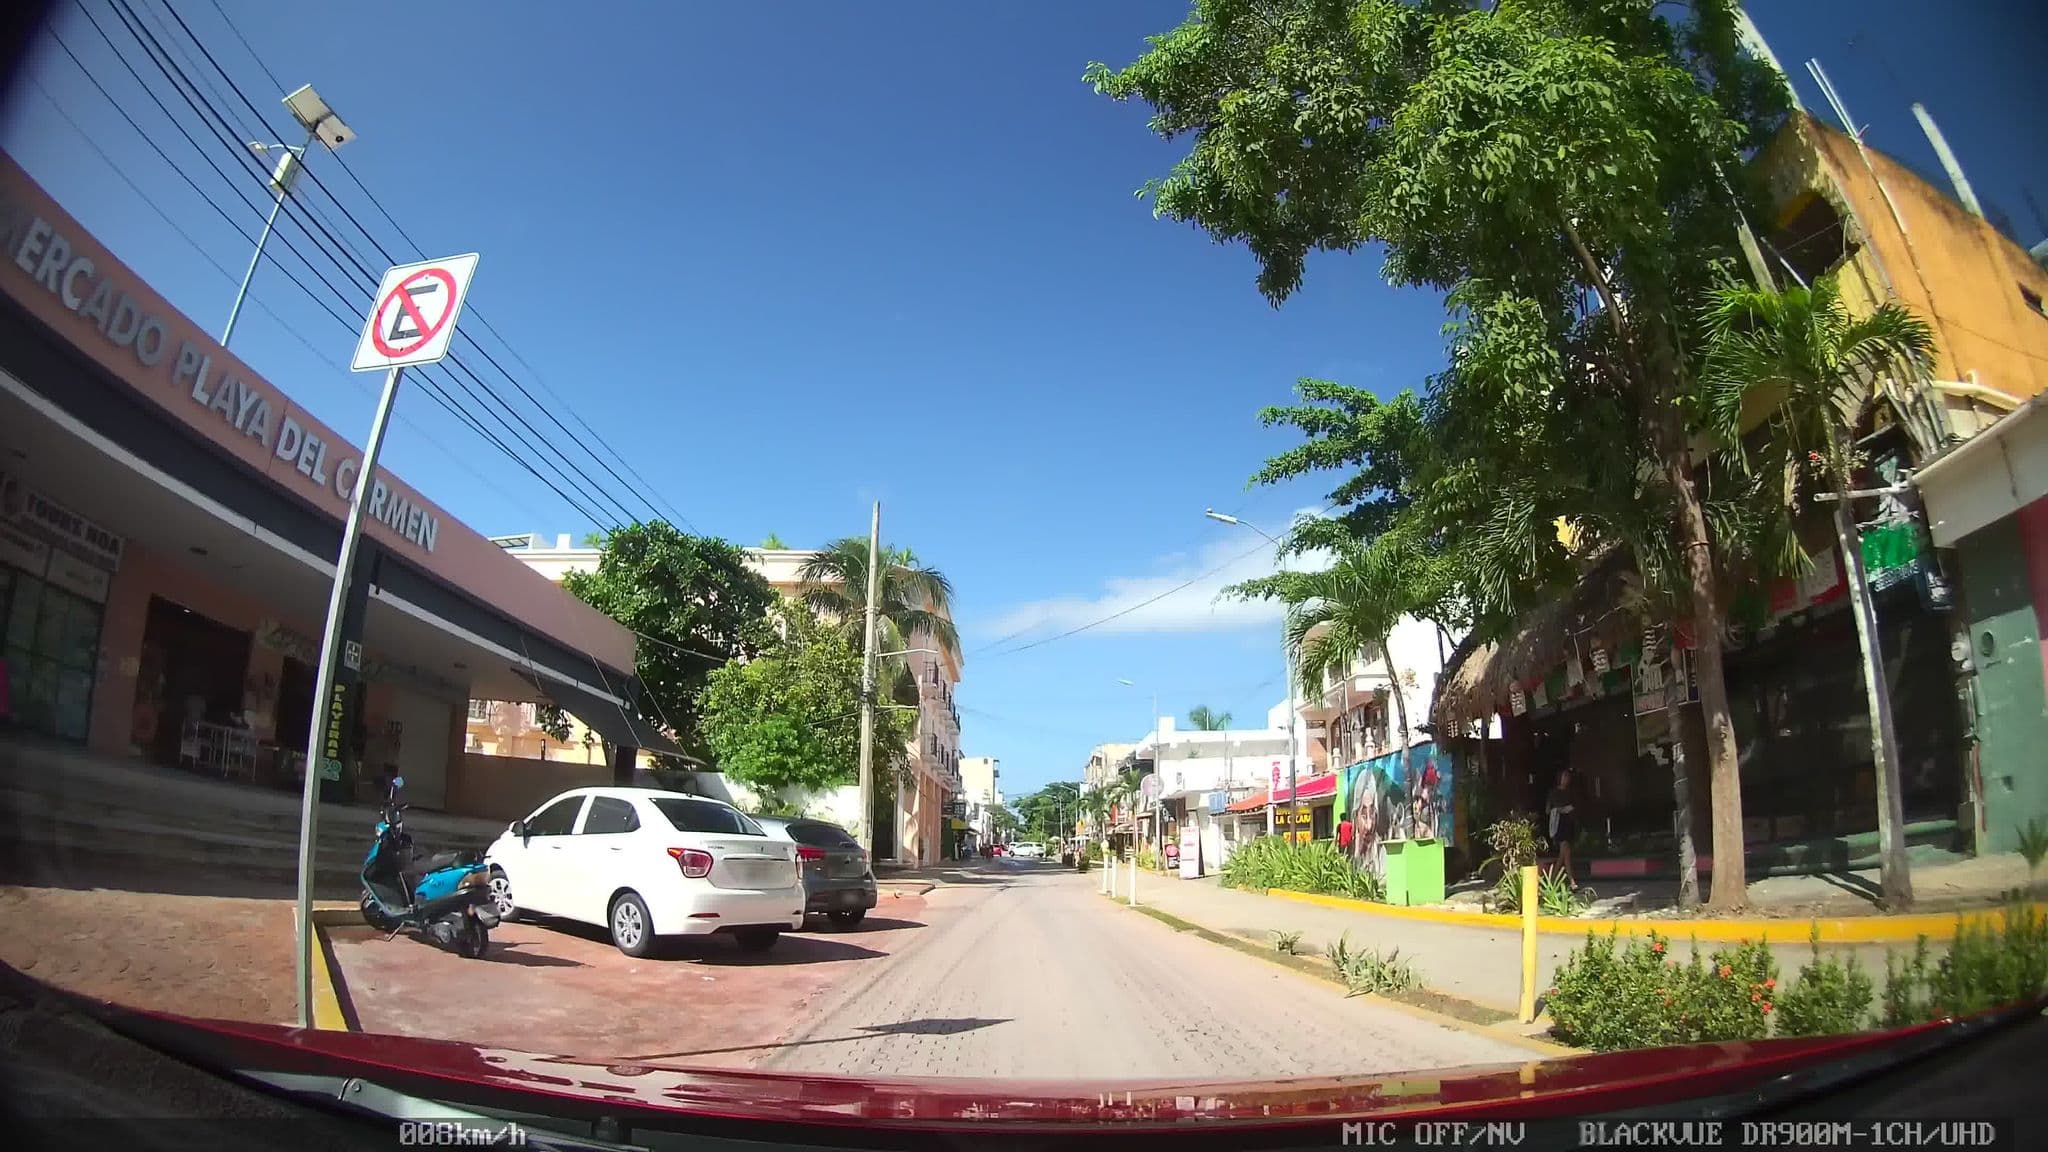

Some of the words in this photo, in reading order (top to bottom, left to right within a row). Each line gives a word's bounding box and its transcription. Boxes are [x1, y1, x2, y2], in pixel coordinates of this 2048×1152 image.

[388, 283, 438, 341] E
[172, 338, 274, 447] PLAYA
[275, 415, 328, 486] DEL
[335, 457, 438, 552] CRMEN
